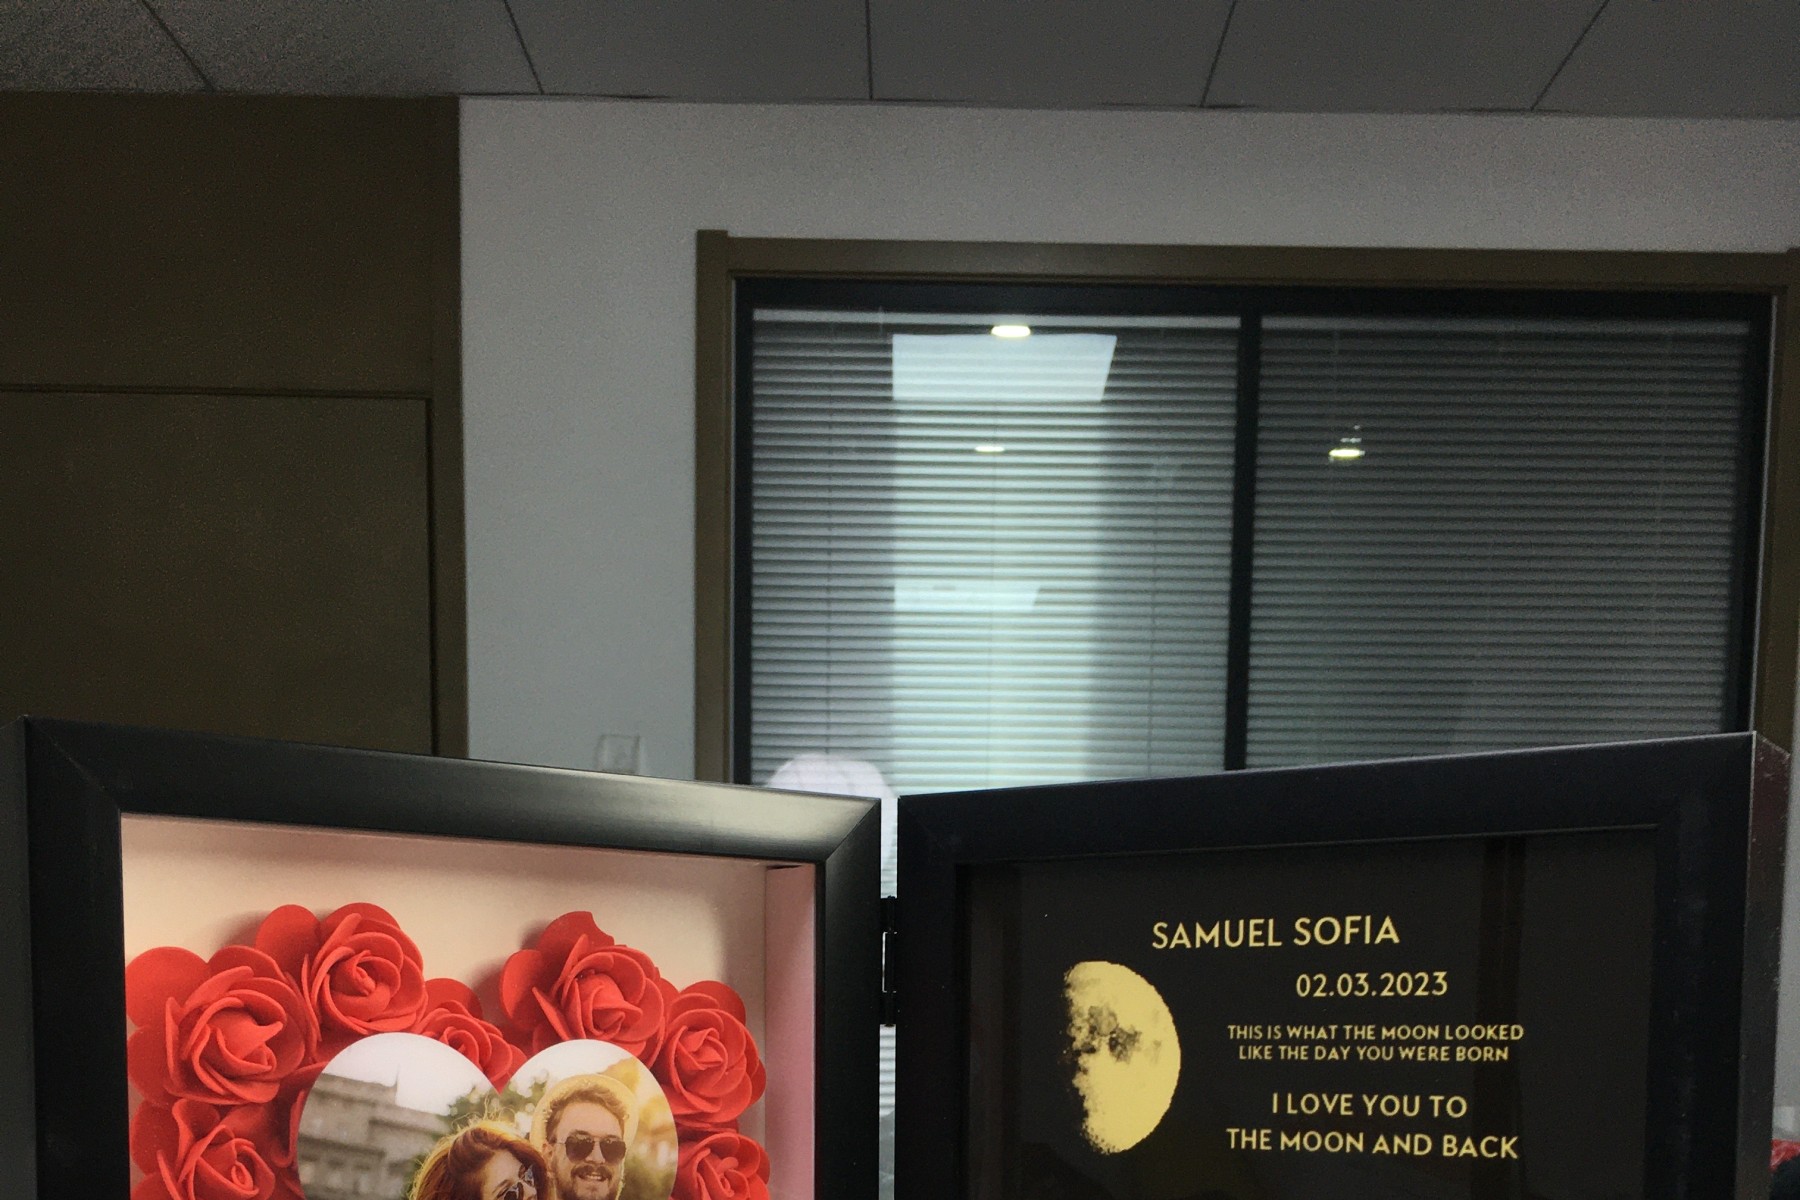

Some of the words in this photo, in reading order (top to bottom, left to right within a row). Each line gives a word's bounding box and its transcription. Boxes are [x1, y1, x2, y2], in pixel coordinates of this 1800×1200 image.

[1151, 918, 1283, 949] SAMUEL
[1293, 915, 1400, 946] SOFIA
[1295, 971, 1448, 998] 02.03.2023
[1228, 1024, 1262, 1040] THIS
[1266, 1024, 1281, 1040] IS
[1287, 1024, 1338, 1040] WHAT
[1343, 1024, 1376, 1040] THE
[1381, 1025, 1440, 1040] MOON
[1445, 1024, 1524, 1040] LOOKED
[1239, 1045, 1273, 1060] LIKE
[1279, 1045, 1309, 1060] THE
[1314, 1045, 1351, 1060] DAY
[1356, 1045, 1395, 1061] YOU
[1398, 1045, 1450, 1062] WERE
[1456, 1046, 1509, 1062] BORN
[1272, 1093, 1279, 1114] I
[1286, 1094, 1353, 1116] LOVE
[1362, 1094, 1420, 1117] YOU
[1429, 1095, 1467, 1118] TO
[1226, 1128, 1272, 1150] THE
[1280, 1130, 1364, 1153] MOON
[1372, 1133, 1433, 1156] AND
[1442, 1134, 1519, 1159] BACK
